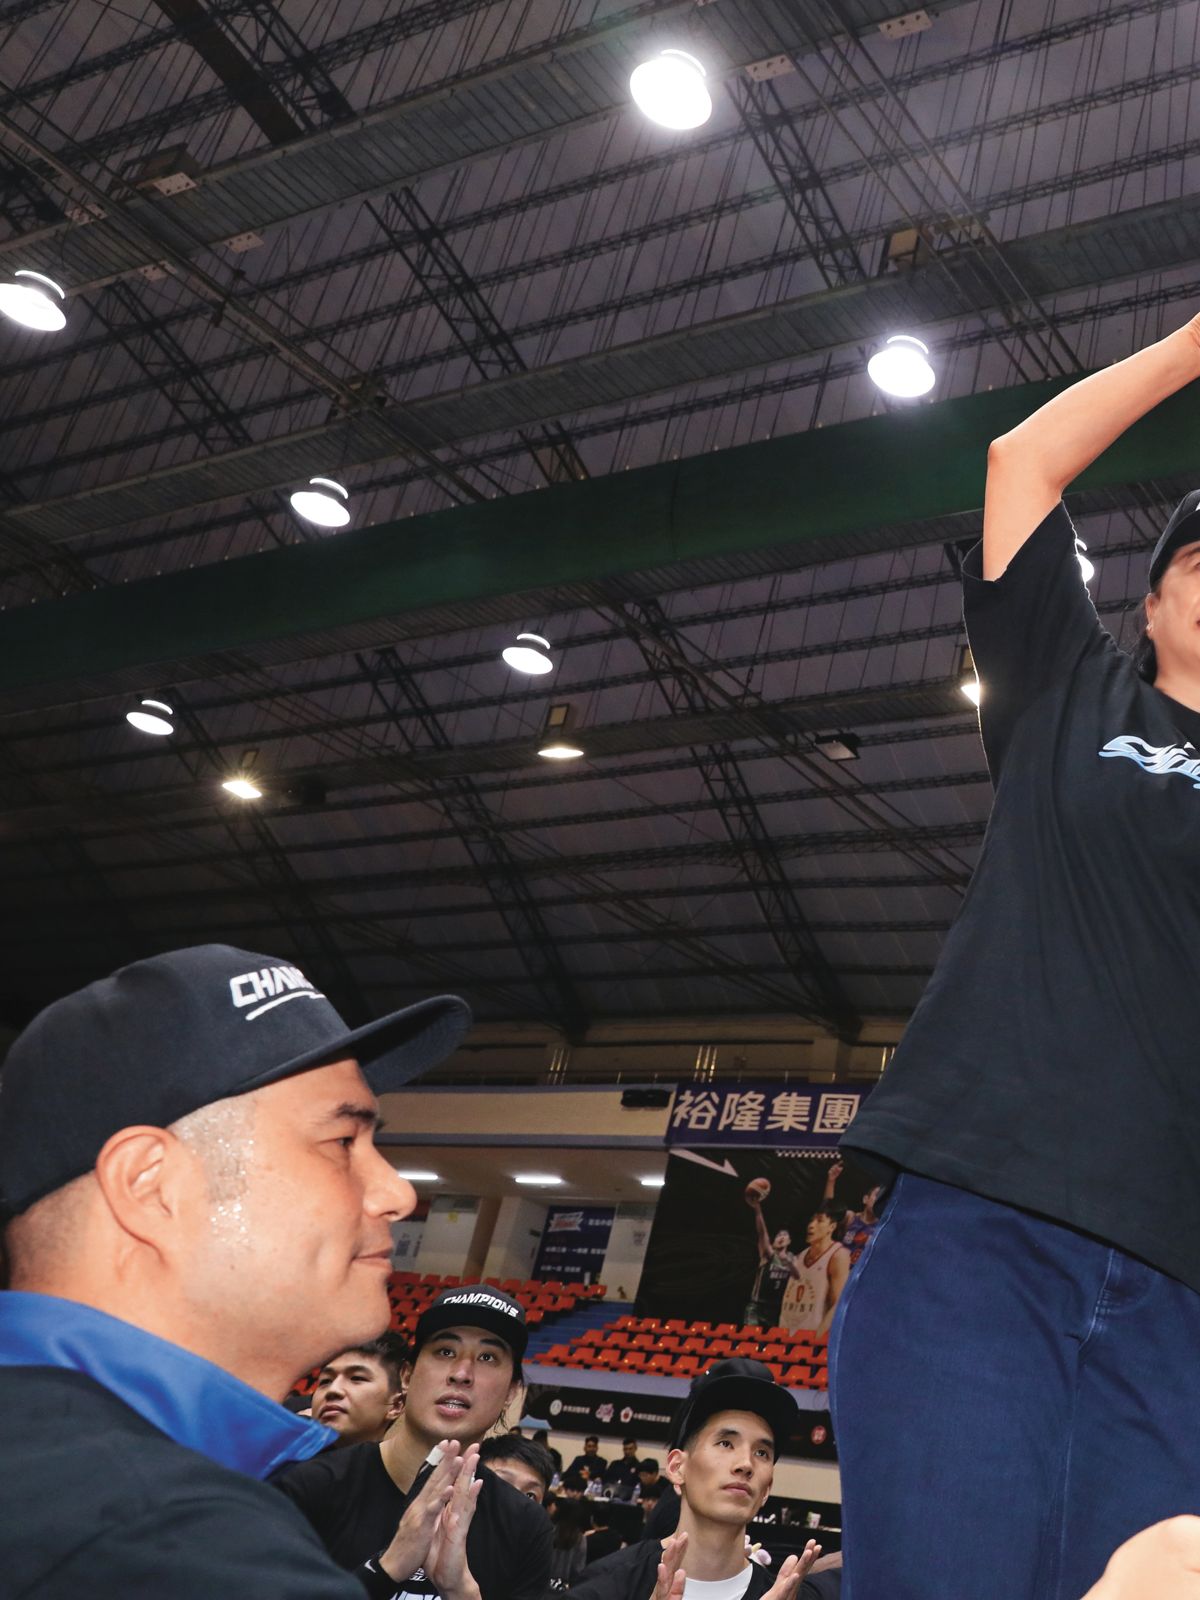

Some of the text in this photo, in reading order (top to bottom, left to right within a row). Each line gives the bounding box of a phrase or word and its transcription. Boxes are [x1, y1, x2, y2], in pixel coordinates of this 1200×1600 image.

[672, 1089, 861, 1134] 裕隆集團
[443, 1292, 519, 1318] CHAMPIONS
